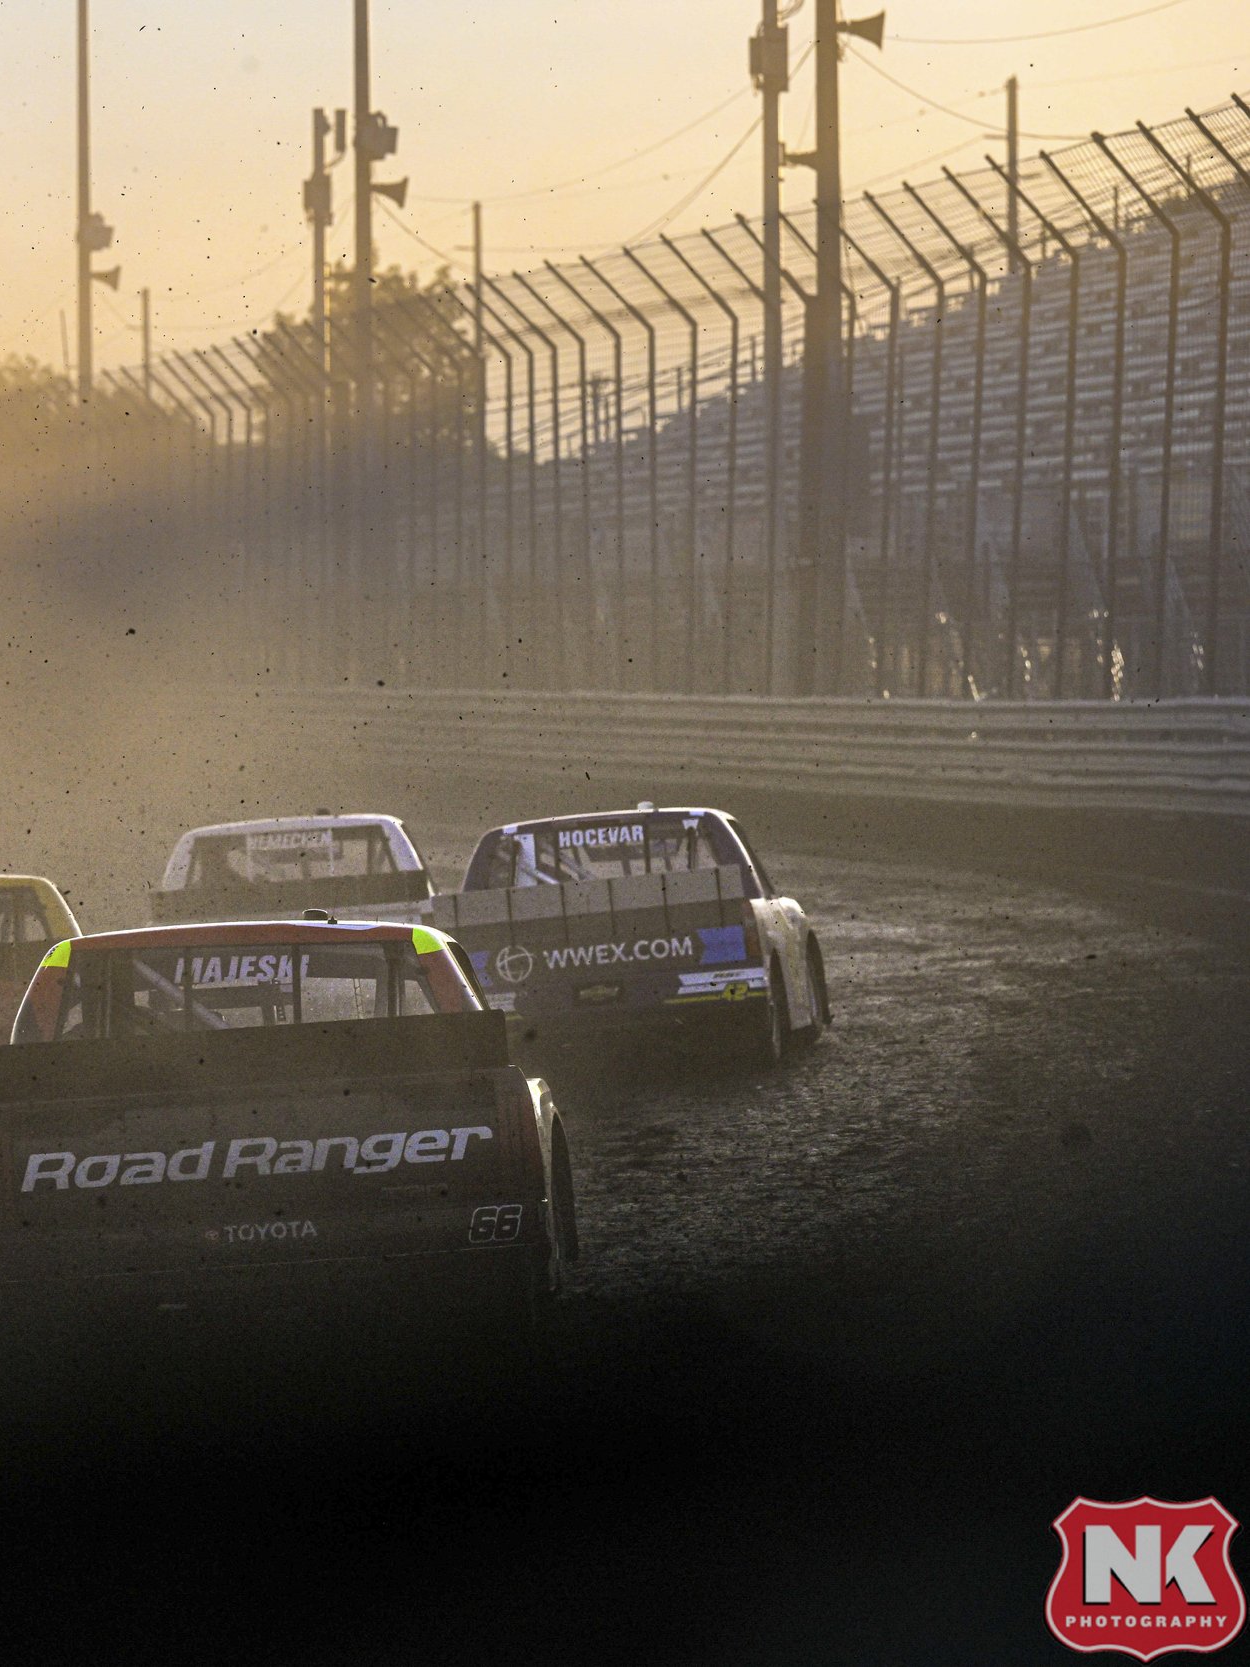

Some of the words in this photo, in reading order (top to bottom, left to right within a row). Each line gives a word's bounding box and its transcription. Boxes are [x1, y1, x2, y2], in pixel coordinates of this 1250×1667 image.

[558, 824, 645, 848] HOCEVAR
[543, 936, 693, 970] WWEX.COM
[21, 1141, 216, 1193] Road
[223, 1125, 494, 1179] Ranger
[224, 1220, 318, 1243] TOYOTA
[468, 1204, 523, 1244] 66
